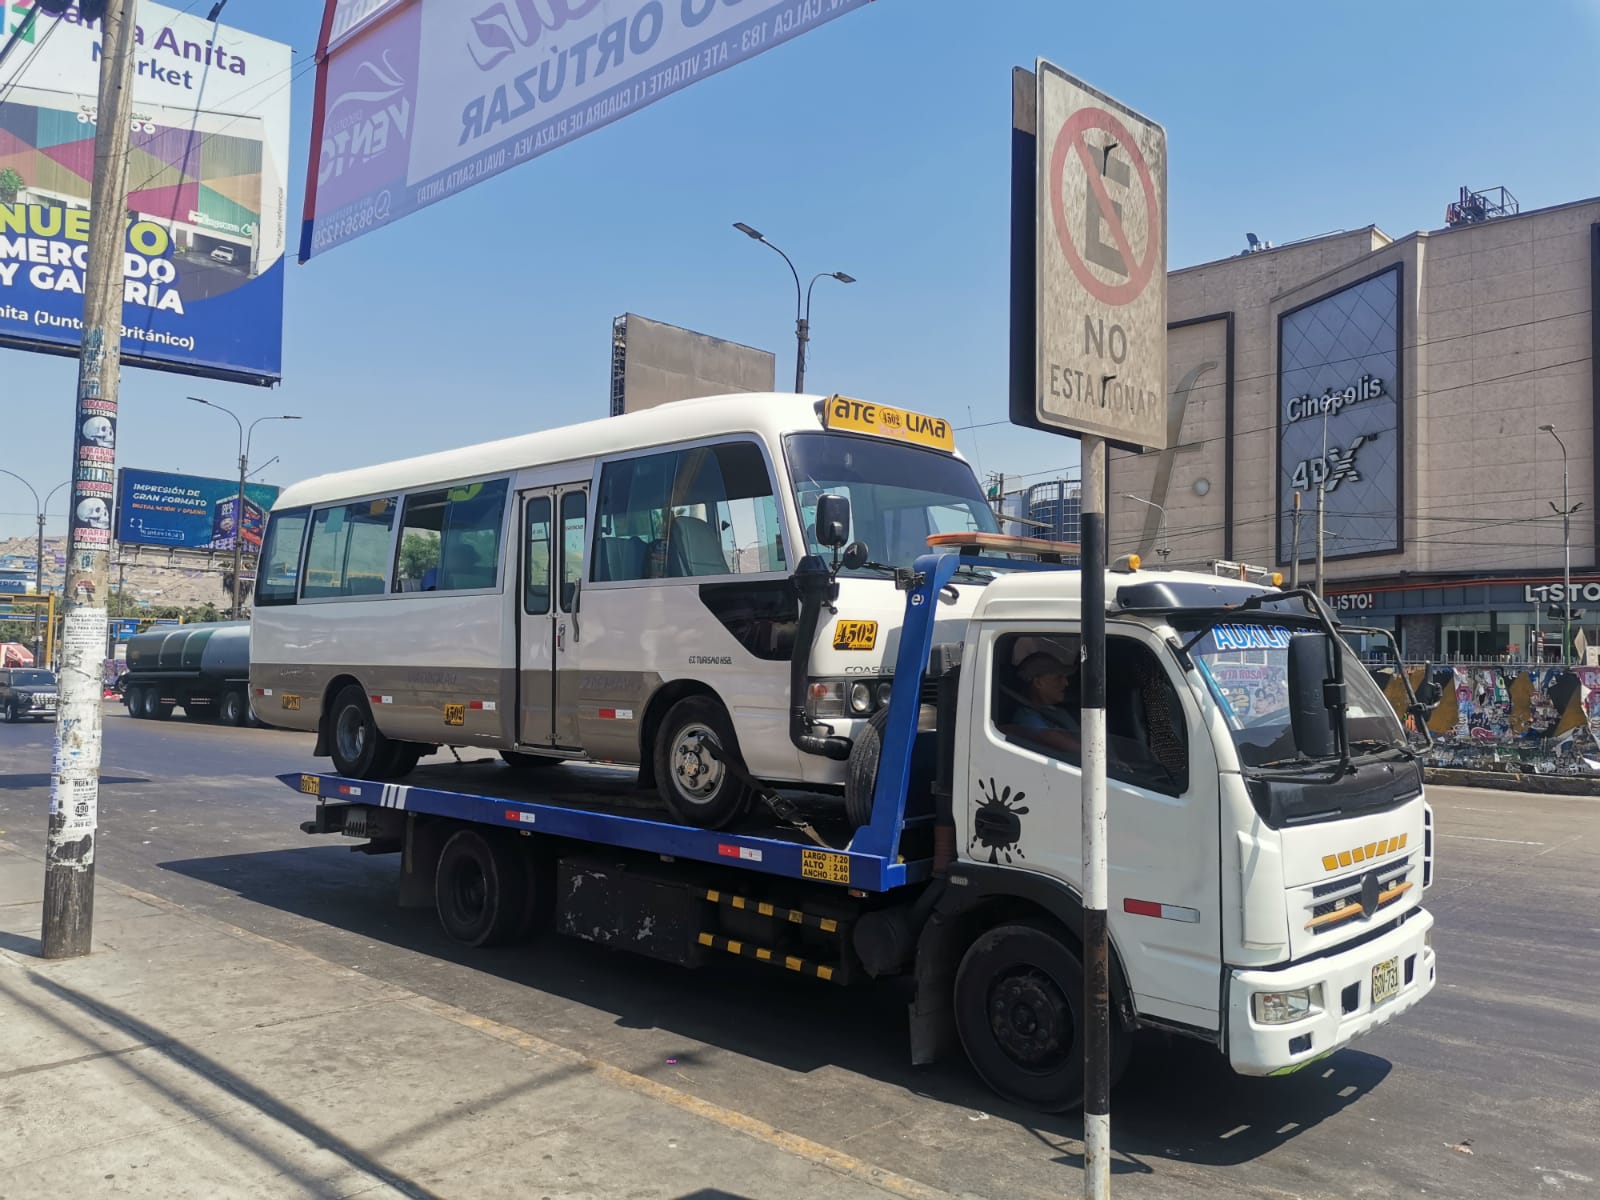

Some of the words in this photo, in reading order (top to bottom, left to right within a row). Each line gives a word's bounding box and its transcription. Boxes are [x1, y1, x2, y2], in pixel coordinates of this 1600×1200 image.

[154, 27, 246, 76] Anita
[0, 203, 169, 256] NUEO
[0, 234, 176, 284] MERCDO
[0, 262, 20, 287] Y
[1084, 314, 1128, 364] NO
[133, 483, 186, 495] IMPRESIÓN
[133, 492, 160, 502] GRAN
[161, 496, 207, 507] FORMATO
[836, 623, 875, 643] 4502
[803, 851, 827, 861] LARGO
[833, 855, 848, 864] 7.20
[803, 860, 824, 869] ALTO
[833, 864, 848, 873] 2.60
[803, 869, 828, 879] ANCHO
[833, 873, 848, 882] 2.40
